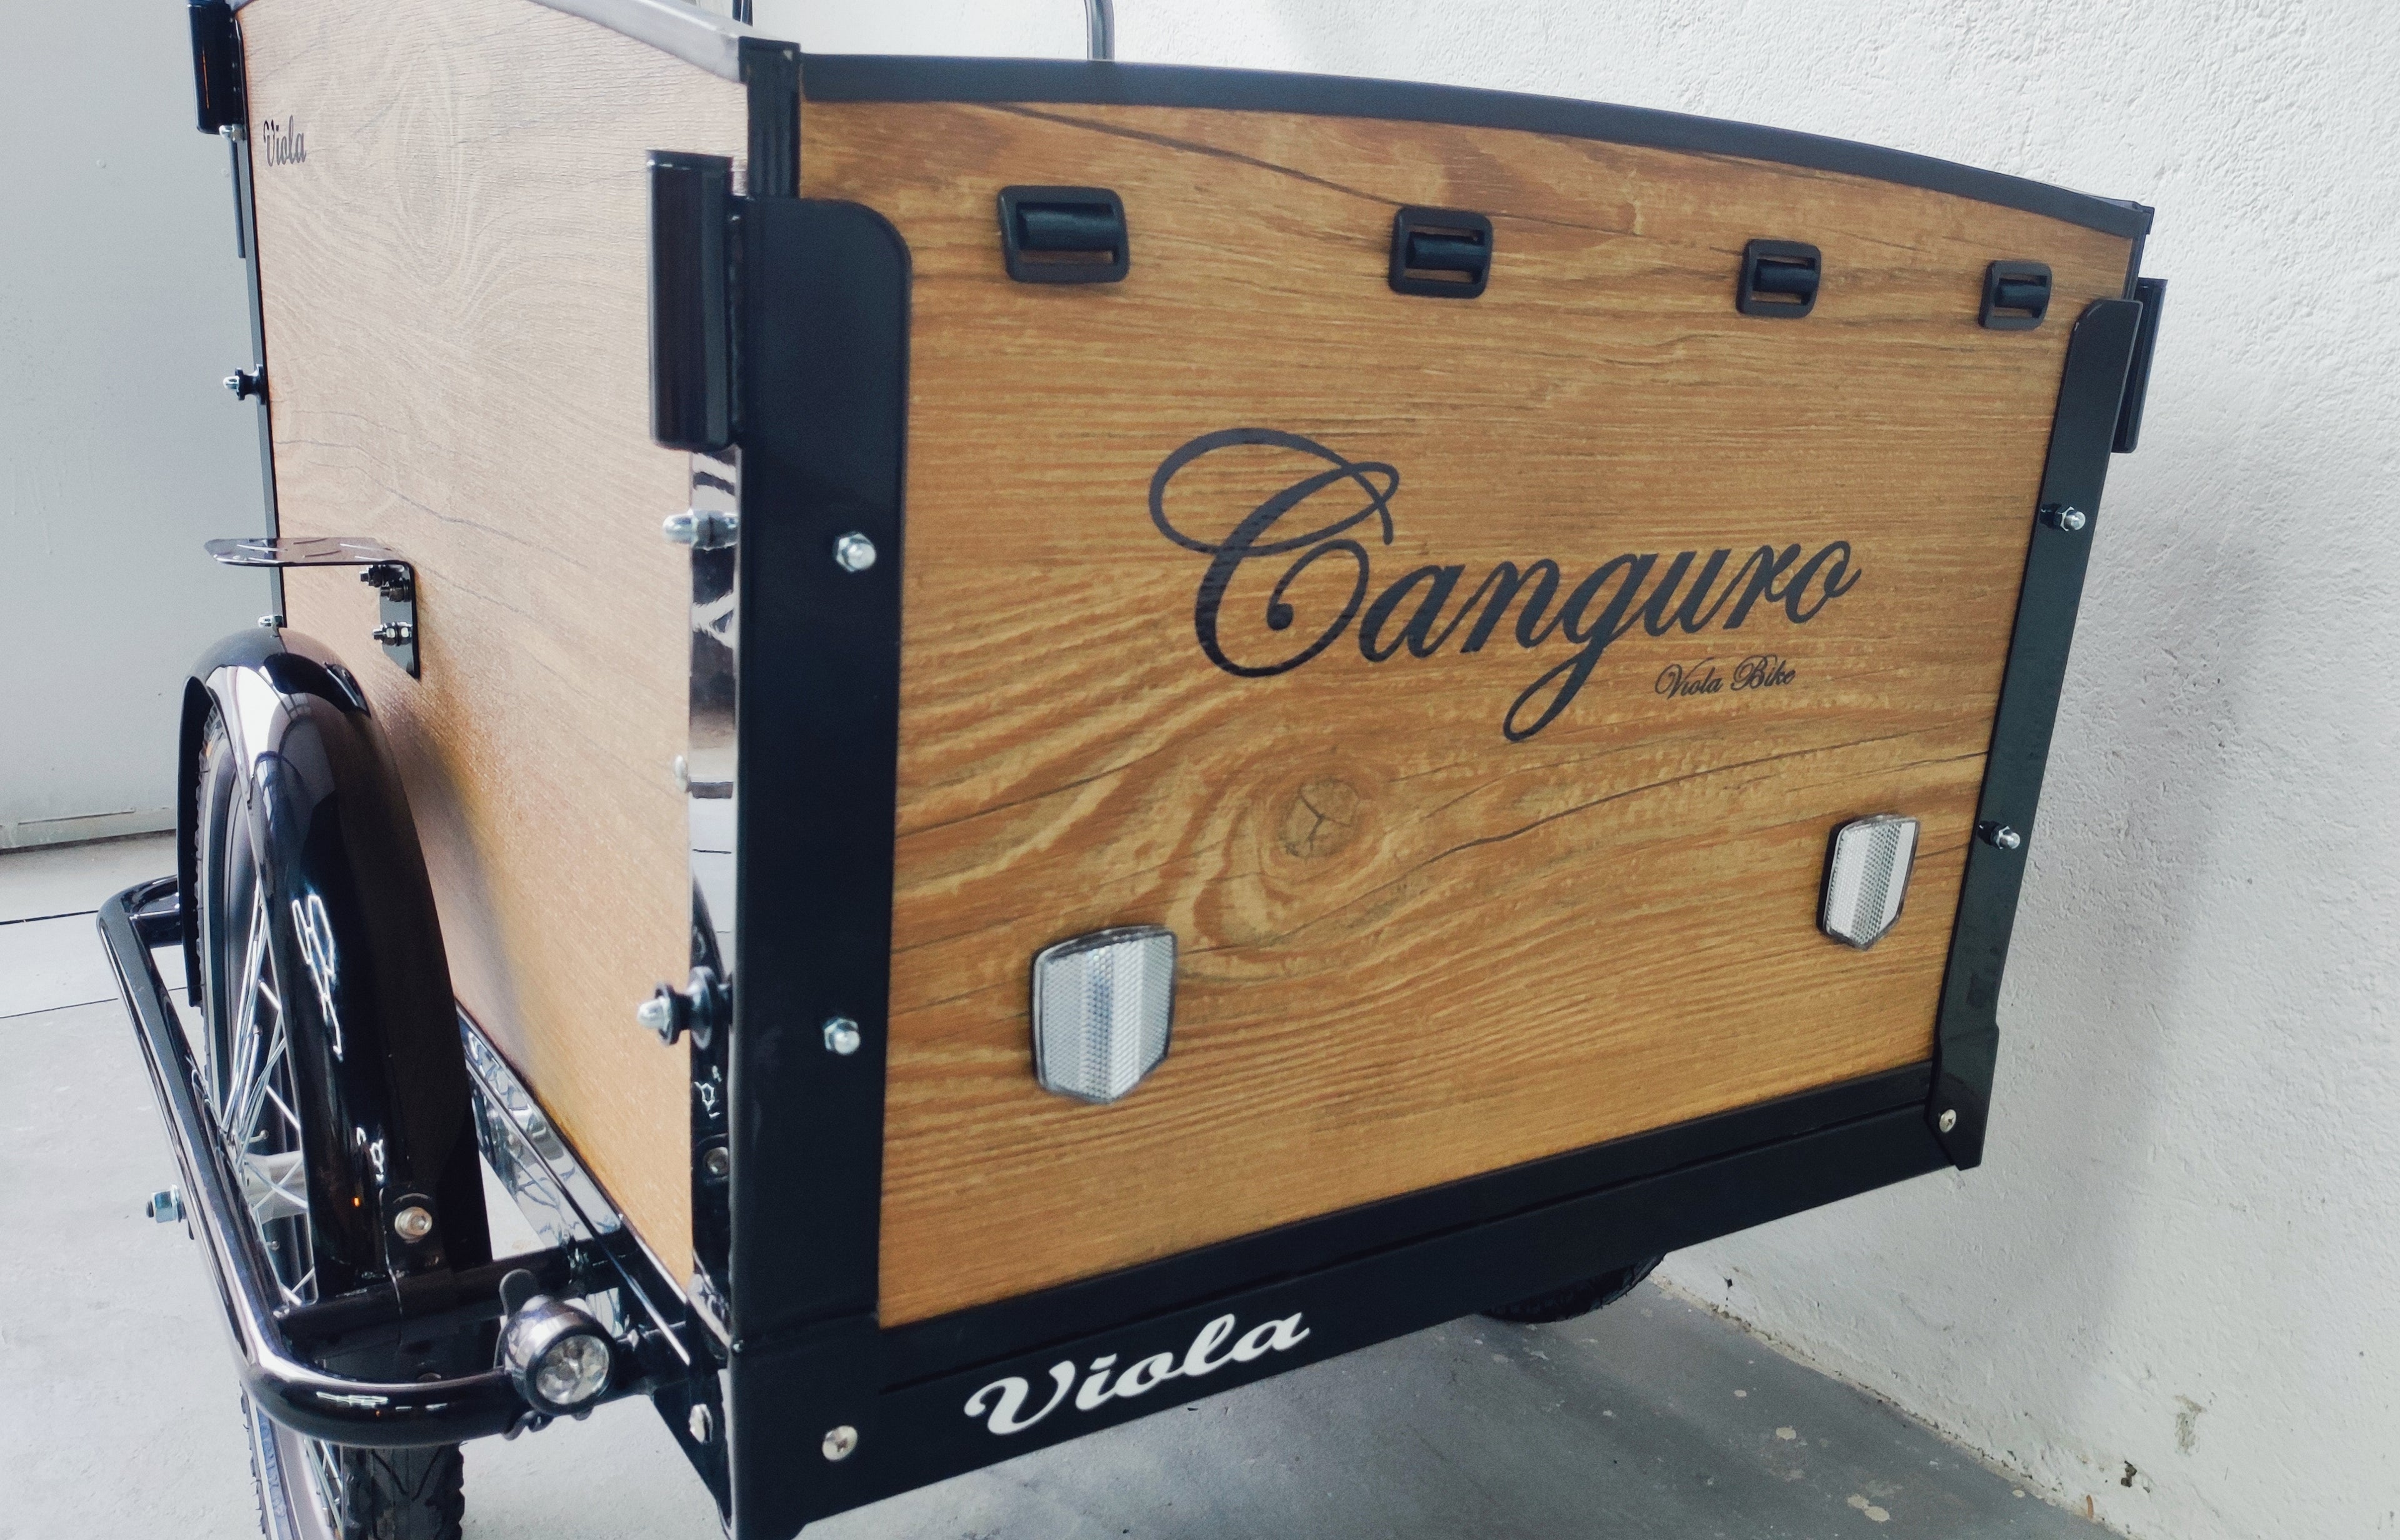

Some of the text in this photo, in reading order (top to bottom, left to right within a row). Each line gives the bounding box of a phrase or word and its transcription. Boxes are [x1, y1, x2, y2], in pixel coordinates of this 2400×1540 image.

[262, 115, 307, 168] Viola
[1148, 428, 1861, 742] Canguro
[1655, 654, 1796, 700] Viola Bike
[963, 1312, 1310, 1436] Viola
